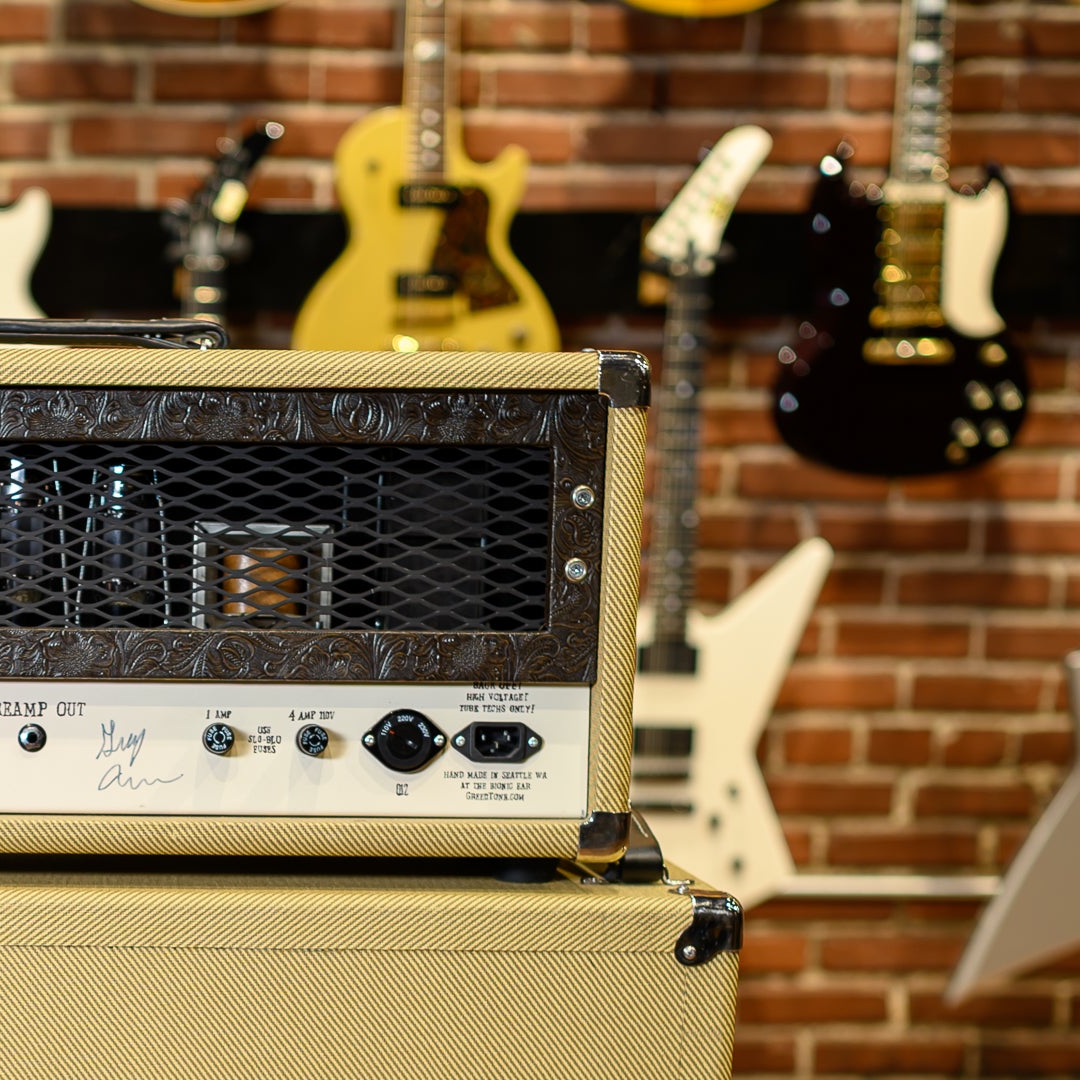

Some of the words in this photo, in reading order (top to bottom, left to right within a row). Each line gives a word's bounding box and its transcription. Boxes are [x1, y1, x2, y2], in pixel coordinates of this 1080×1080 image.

[466, 693, 485, 701] HIGH
[56, 701, 87, 717] OUT
[459, 704, 479, 713] TUBE
[483, 705, 506, 713] TECHS
[206, 710, 210, 719] 1
[215, 710, 232, 719] AMP
[288, 709, 295, 721] 4
[298, 710, 316, 721] AMP
[207, 726, 218, 741] FUSE
[221, 726, 232, 741] FUSE
[257, 726, 271, 734] USE
[314, 727, 327, 741] FUSE
[303, 730, 312, 745] FUSE
[253, 745, 276, 754] FUSES
[443, 771, 464, 779] HAND
[467, 771, 487, 779] MADE
[490, 771, 498, 779] IN
[501, 771, 532, 779] SEATTLE
[490, 782, 513, 790] BIONIC
[516, 782, 531, 790] EAR
